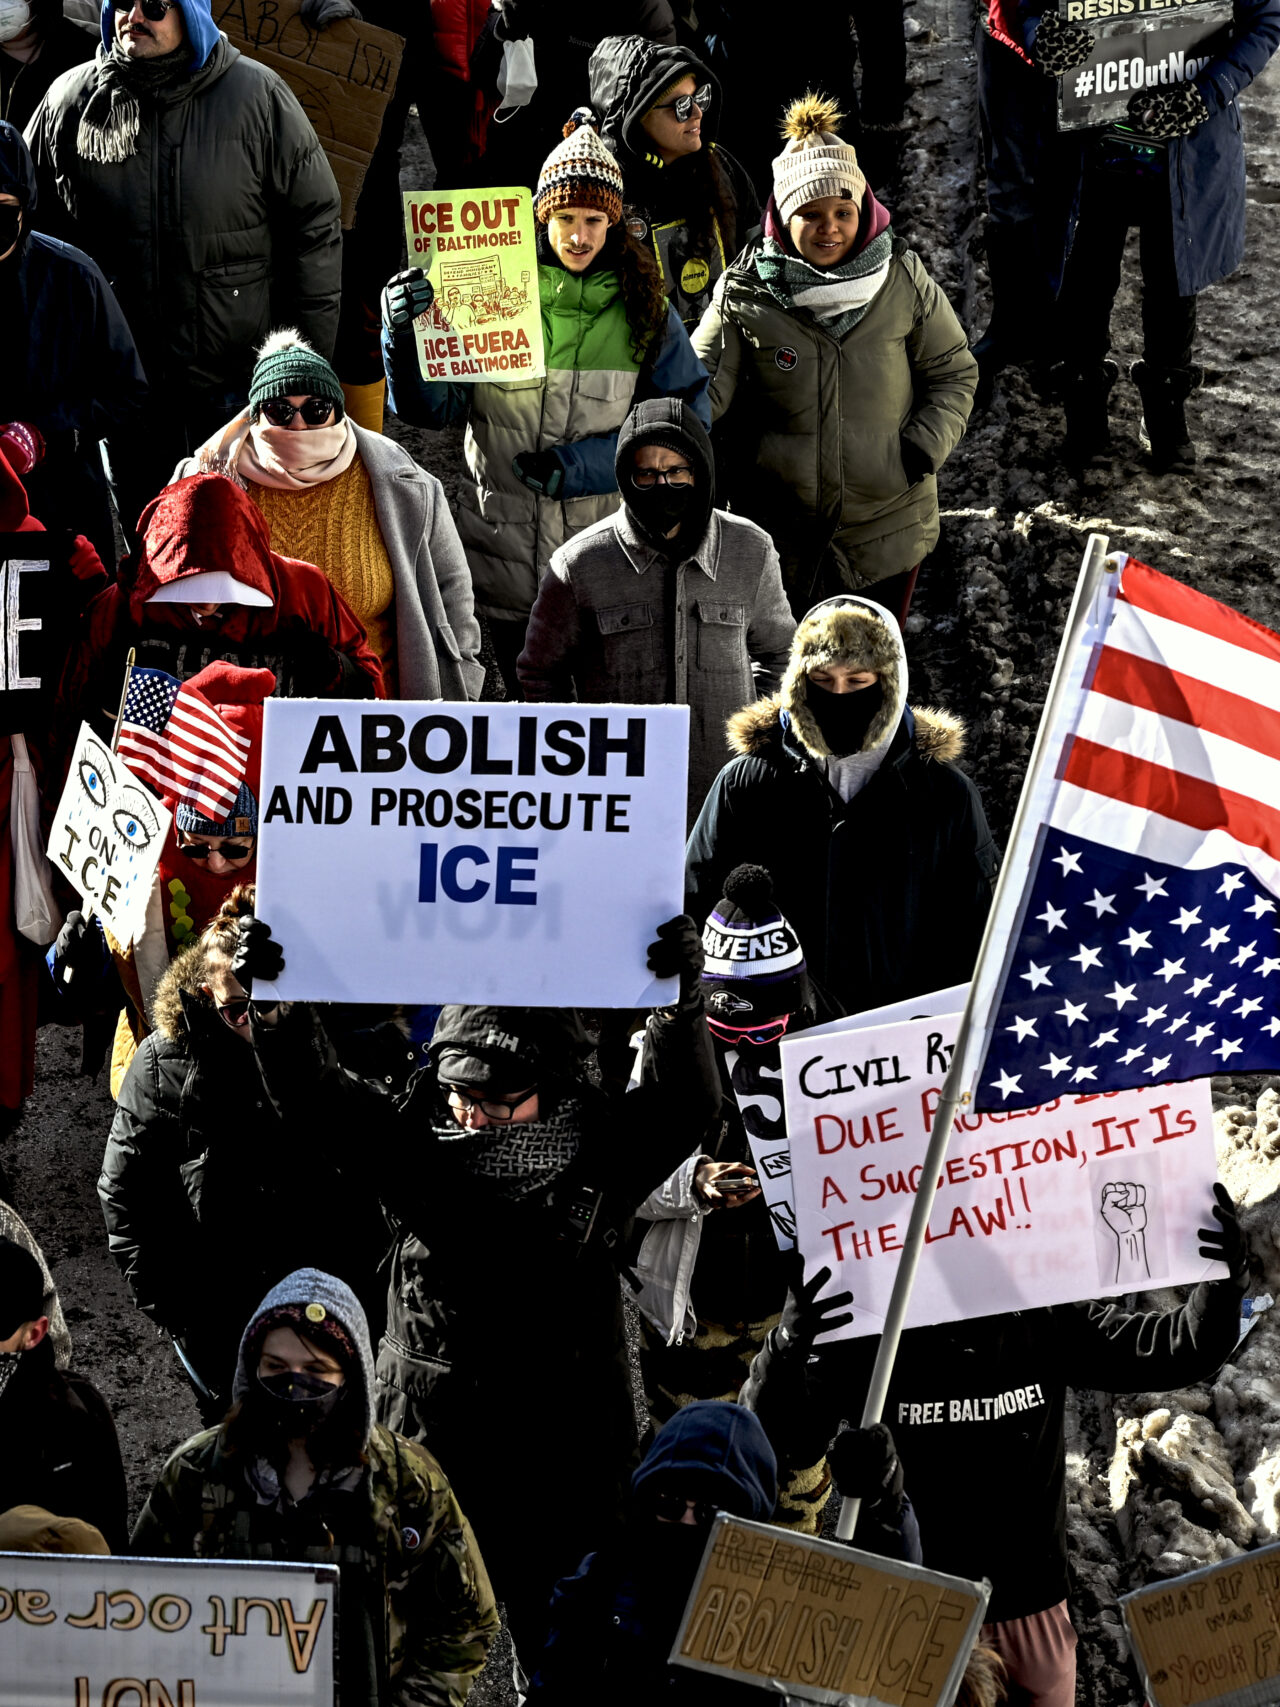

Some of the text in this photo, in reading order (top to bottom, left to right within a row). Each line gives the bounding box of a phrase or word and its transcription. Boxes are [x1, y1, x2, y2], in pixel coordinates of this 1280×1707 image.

[212, 0, 392, 92] ABOLISH
[411, 199, 520, 234] ICE OUT
[414, 230, 522, 253] OF BALTIMORE!
[463, 328, 530, 355] FUERA
[427, 352, 532, 378] DE BALTIMORE!
[299, 714, 647, 777] ABOLISH
[263, 785, 632, 833] AND PROSECUTE
[89, 826, 116, 866] ON
[418, 842, 539, 905] ICE
[486, 1030, 519, 1053] HH
[799, 1055, 911, 1099] CIVIL
[814, 1107, 904, 1155] DUE
[821, 1176, 848, 1209] A
[1092, 1117, 1140, 1156] IT
[1149, 1104, 1197, 1144] IS
[821, 1221, 904, 1261] THE
[924, 1177, 1032, 1244] LAW!!
[898, 1402, 944, 1425] FREE
[1142, 1583, 1207, 1624] WHAT
[680, 1583, 965, 1698] ABOLISH ICE
